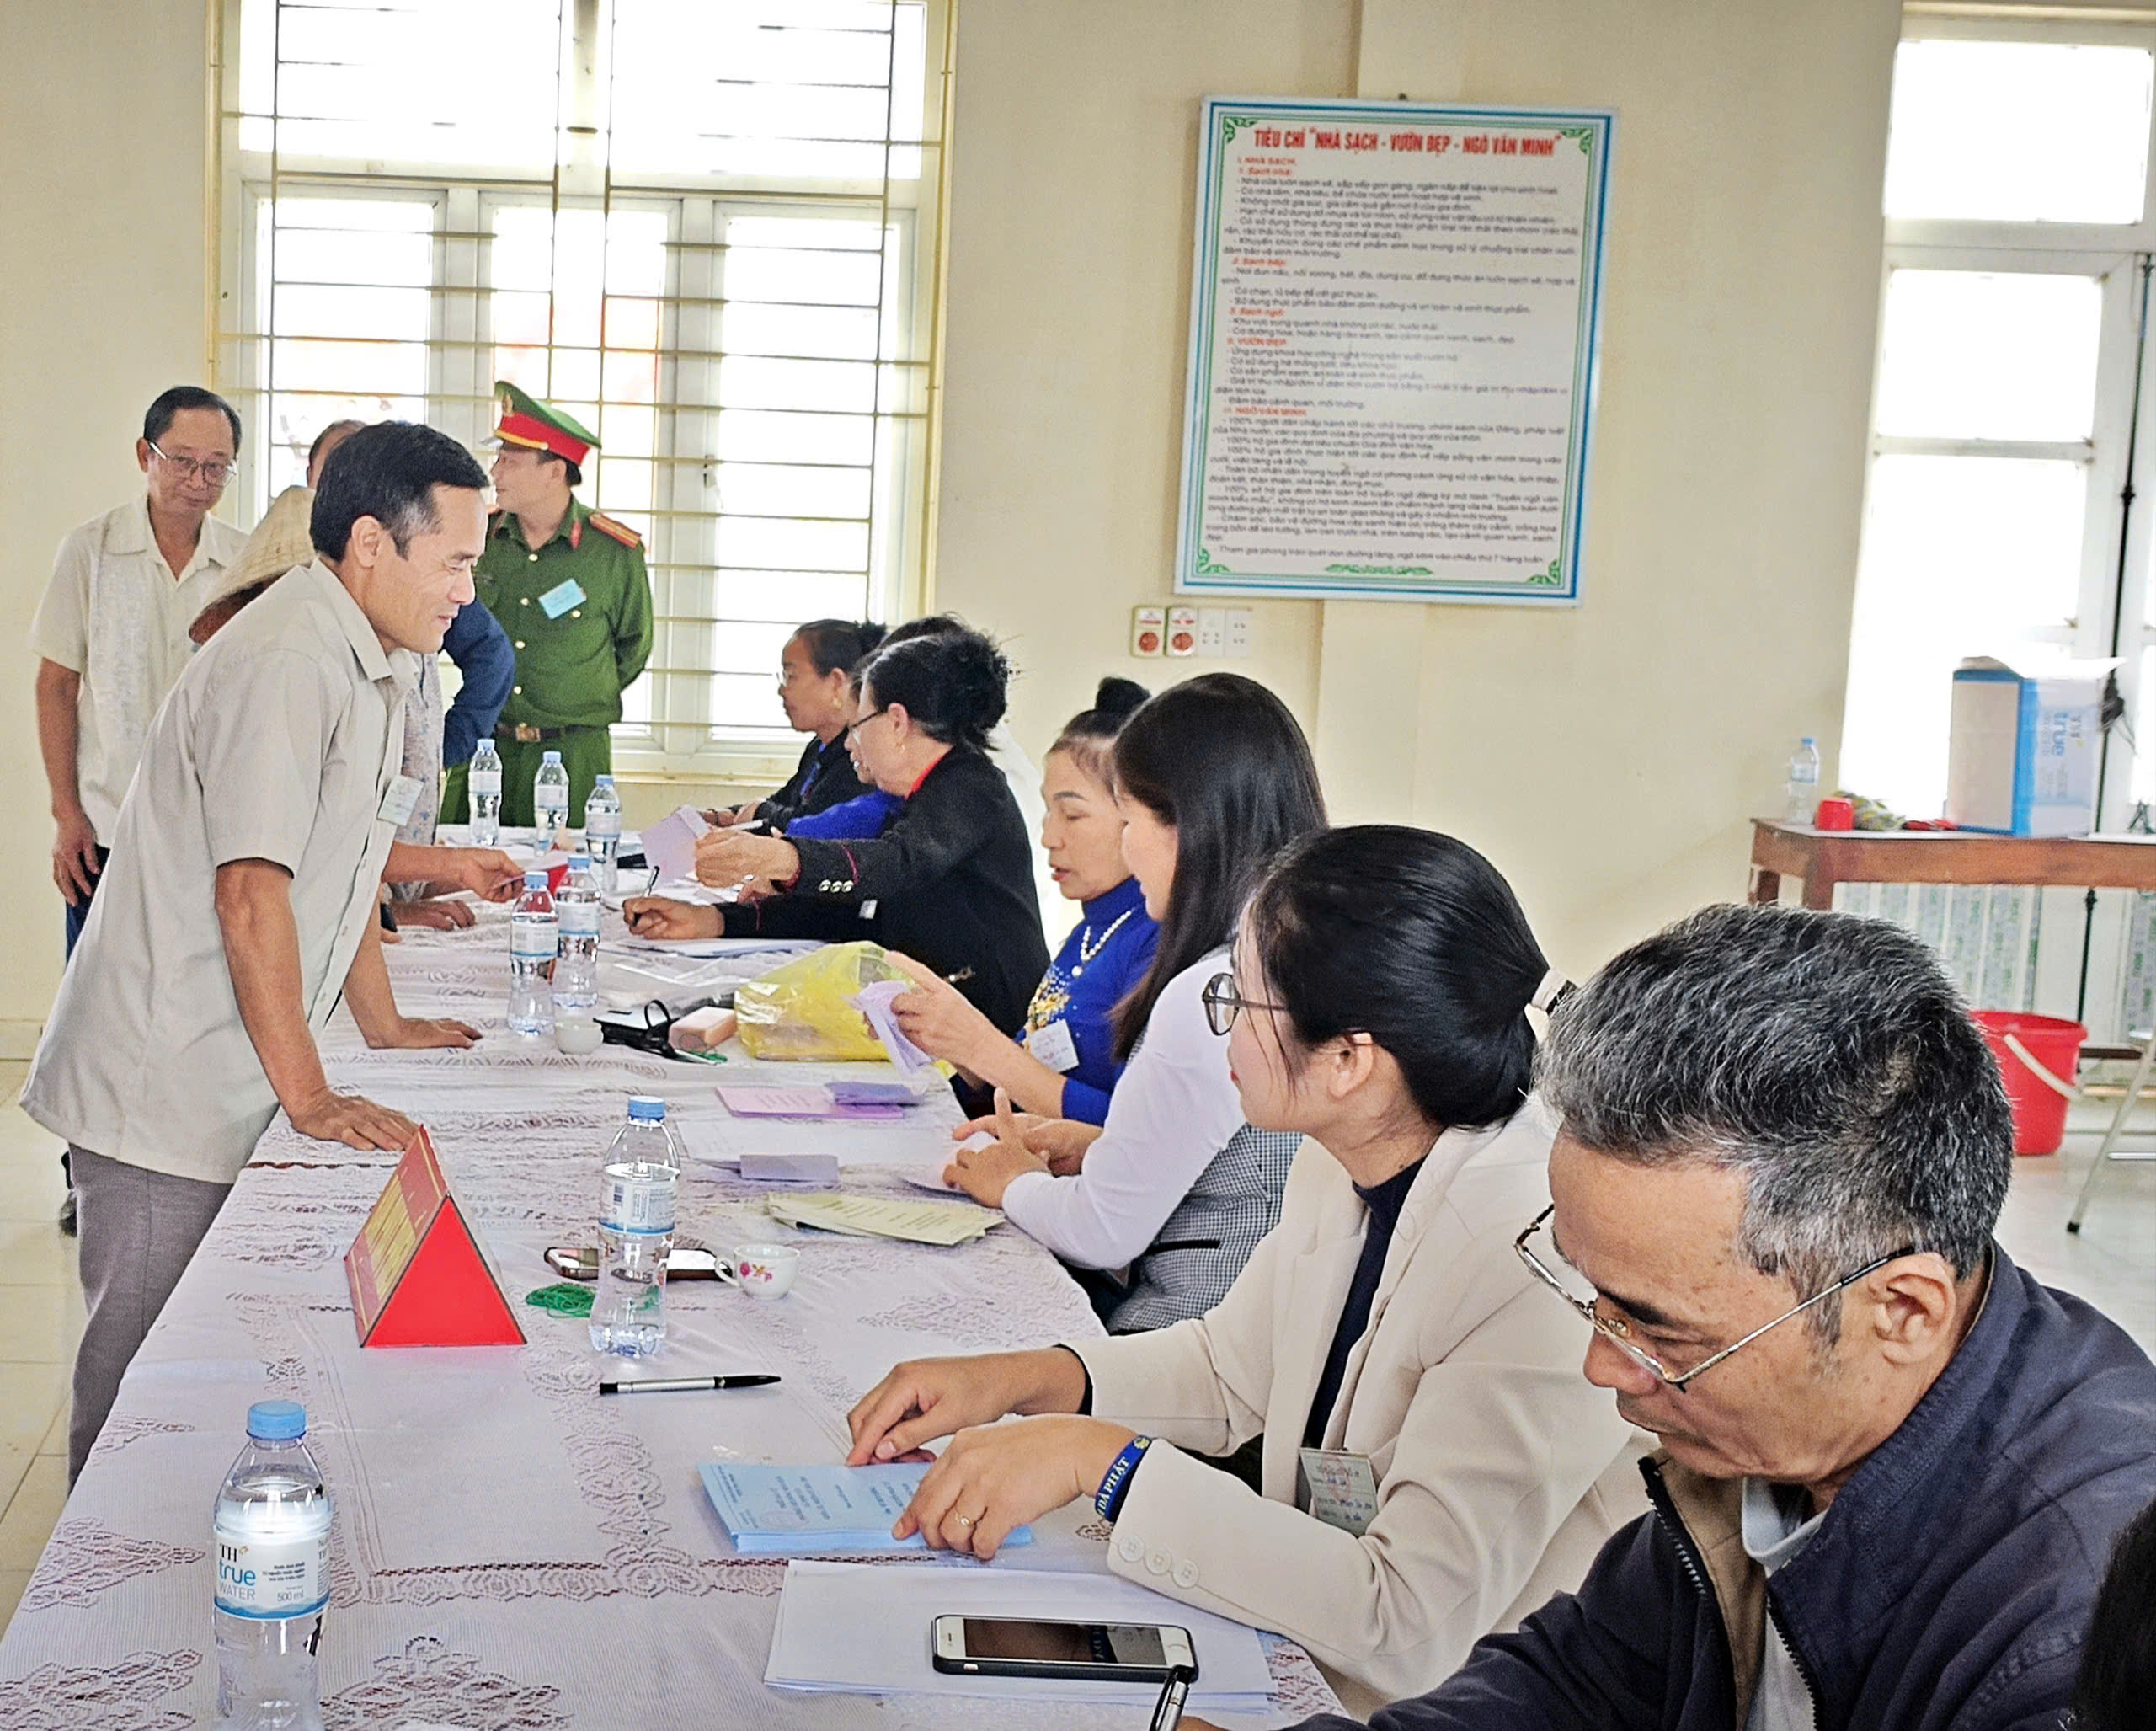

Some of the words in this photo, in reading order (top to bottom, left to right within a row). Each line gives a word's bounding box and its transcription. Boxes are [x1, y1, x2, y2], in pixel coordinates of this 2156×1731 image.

[1255, 127, 1281, 148] TIÊU
[1284, 128, 1305, 149] CHÍ
[1345, 131, 1378, 154] SẠCH
[1390, 131, 1422, 152] VƯỜN
[1427, 133, 1450, 157] ĐẸP
[1492, 135, 1518, 155] VĂN
[1103, 1456, 1129, 1493] PHẬT
[220, 1543, 237, 1563] TH
[219, 1559, 256, 1586] true
[220, 1583, 256, 1601] WATER
[277, 1591, 292, 1602] 500
[293, 1590, 304, 1600] ml
